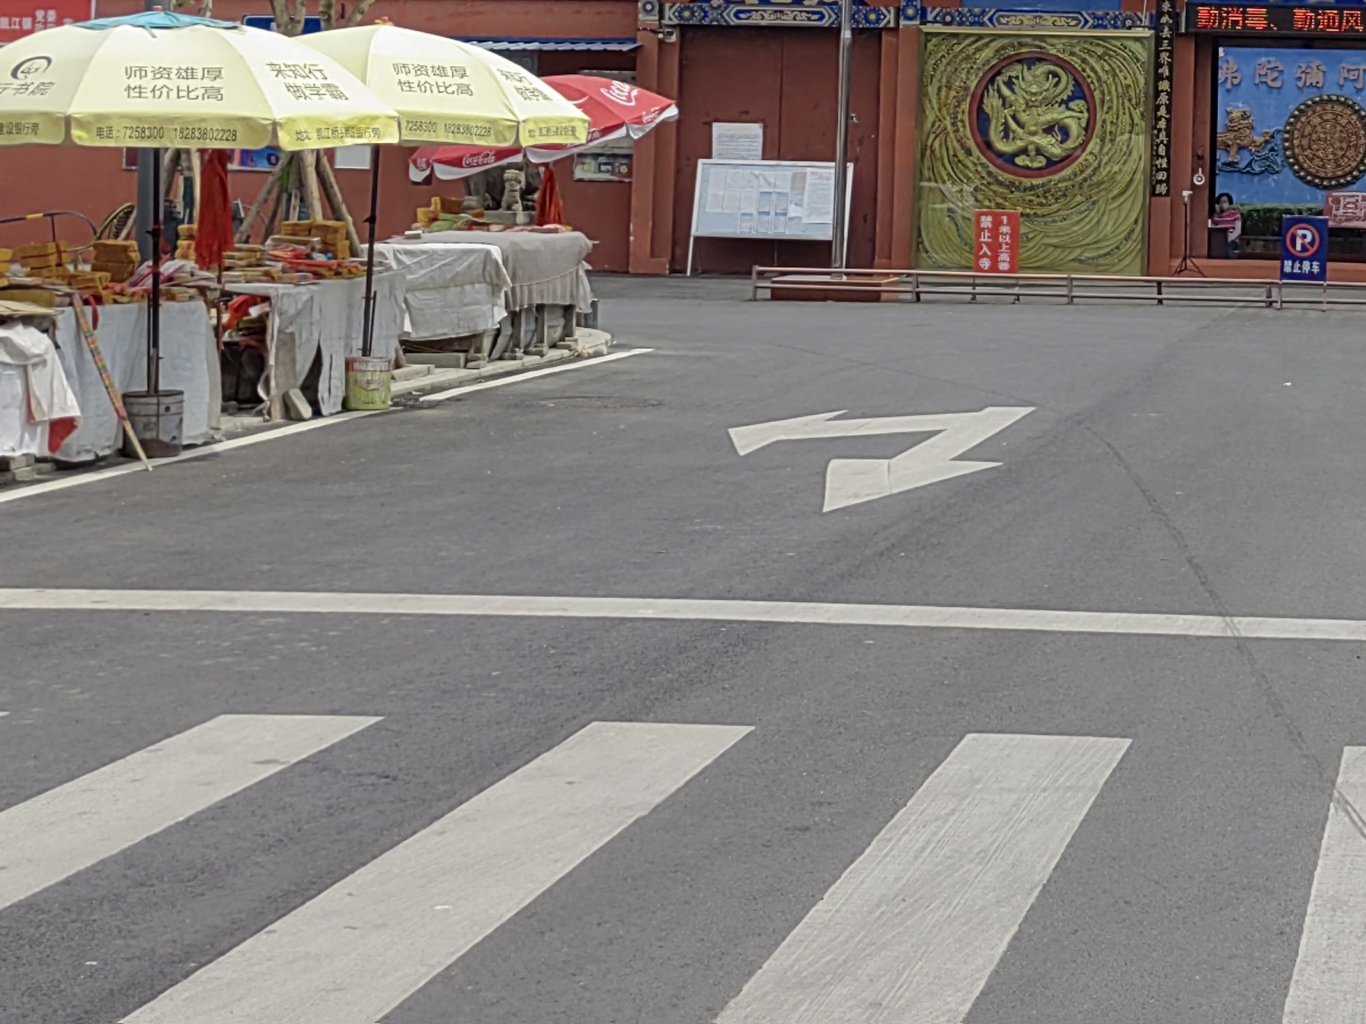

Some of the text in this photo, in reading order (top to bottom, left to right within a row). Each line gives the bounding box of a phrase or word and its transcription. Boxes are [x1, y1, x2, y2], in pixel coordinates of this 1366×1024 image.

[125, 65, 225, 82] 师资雄厚
[392, 62, 469, 79] 师资雄厚
[124, 84, 225, 102] 性价比高
[397, 78, 475, 97] 性价比高
[174, 128, 238, 142] 18283802228
[1283, 260, 1320, 274] 禁止停车
